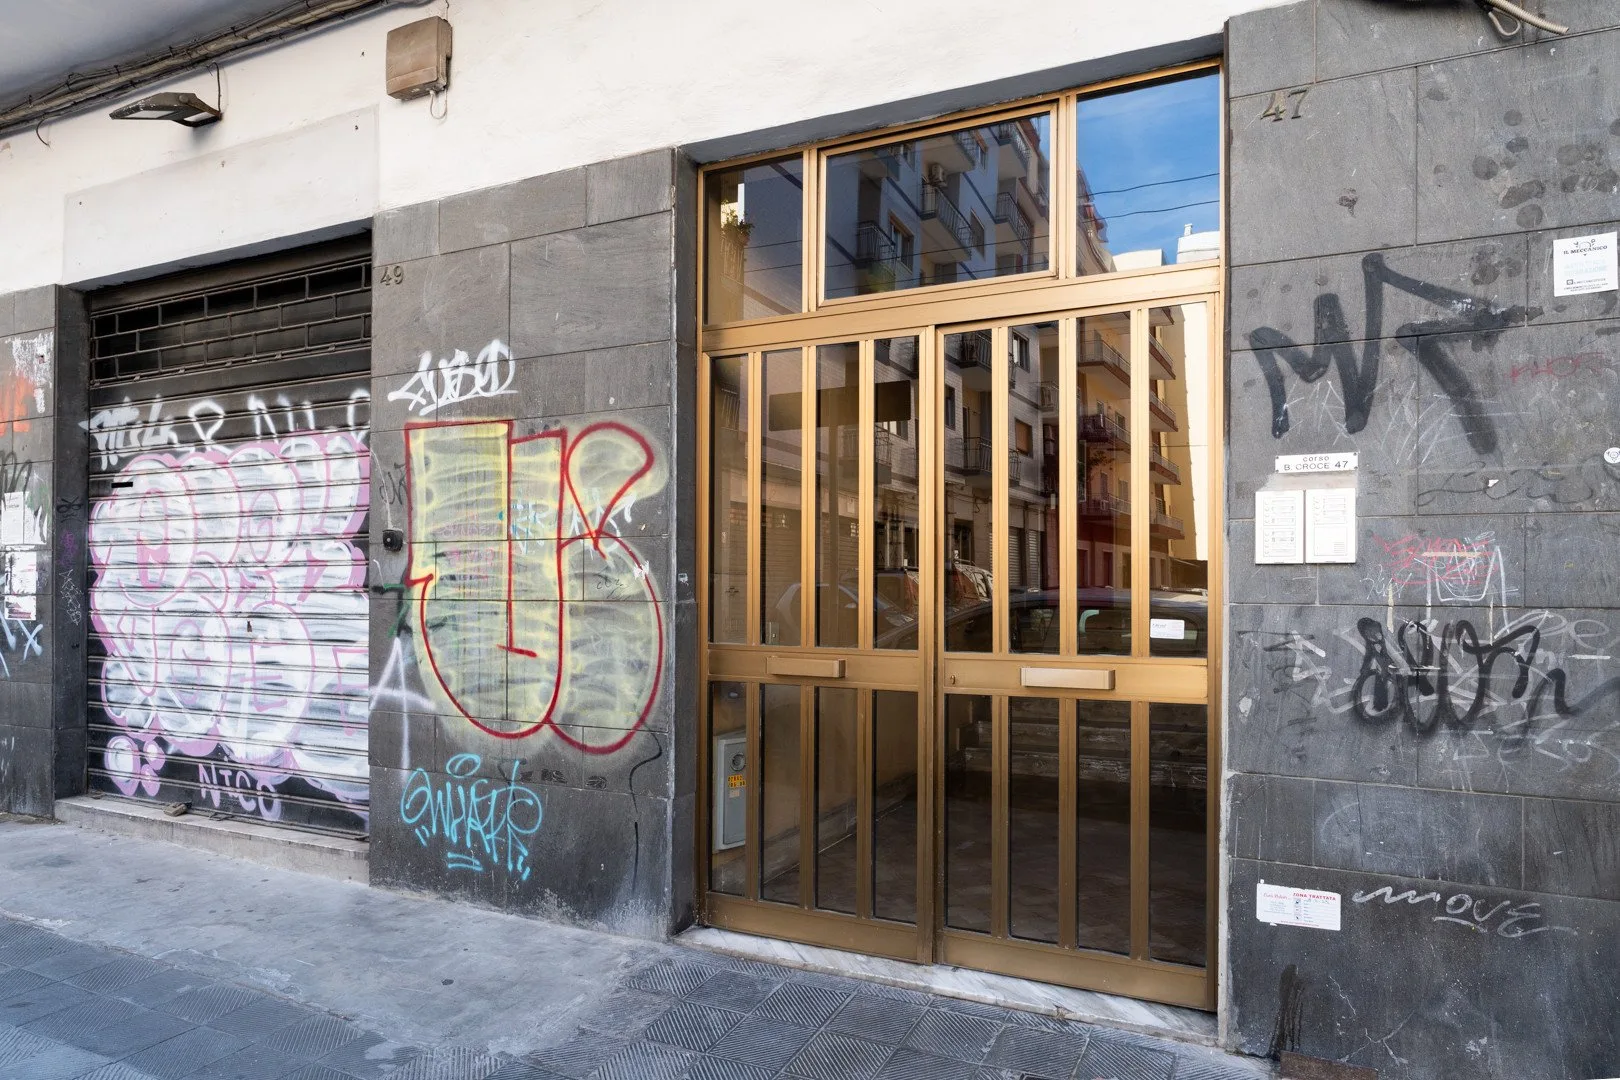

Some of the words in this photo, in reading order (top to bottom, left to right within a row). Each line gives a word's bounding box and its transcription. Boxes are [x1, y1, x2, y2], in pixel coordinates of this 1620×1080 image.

[1260, 86, 1309, 122] 47
[1570, 246, 1607, 254] MECCANICO
[380, 265, 404, 286] 49
[1283, 463, 1293, 471] B.
[1295, 462, 1330, 471] CROCE
[1335, 460, 1349, 468] 47
